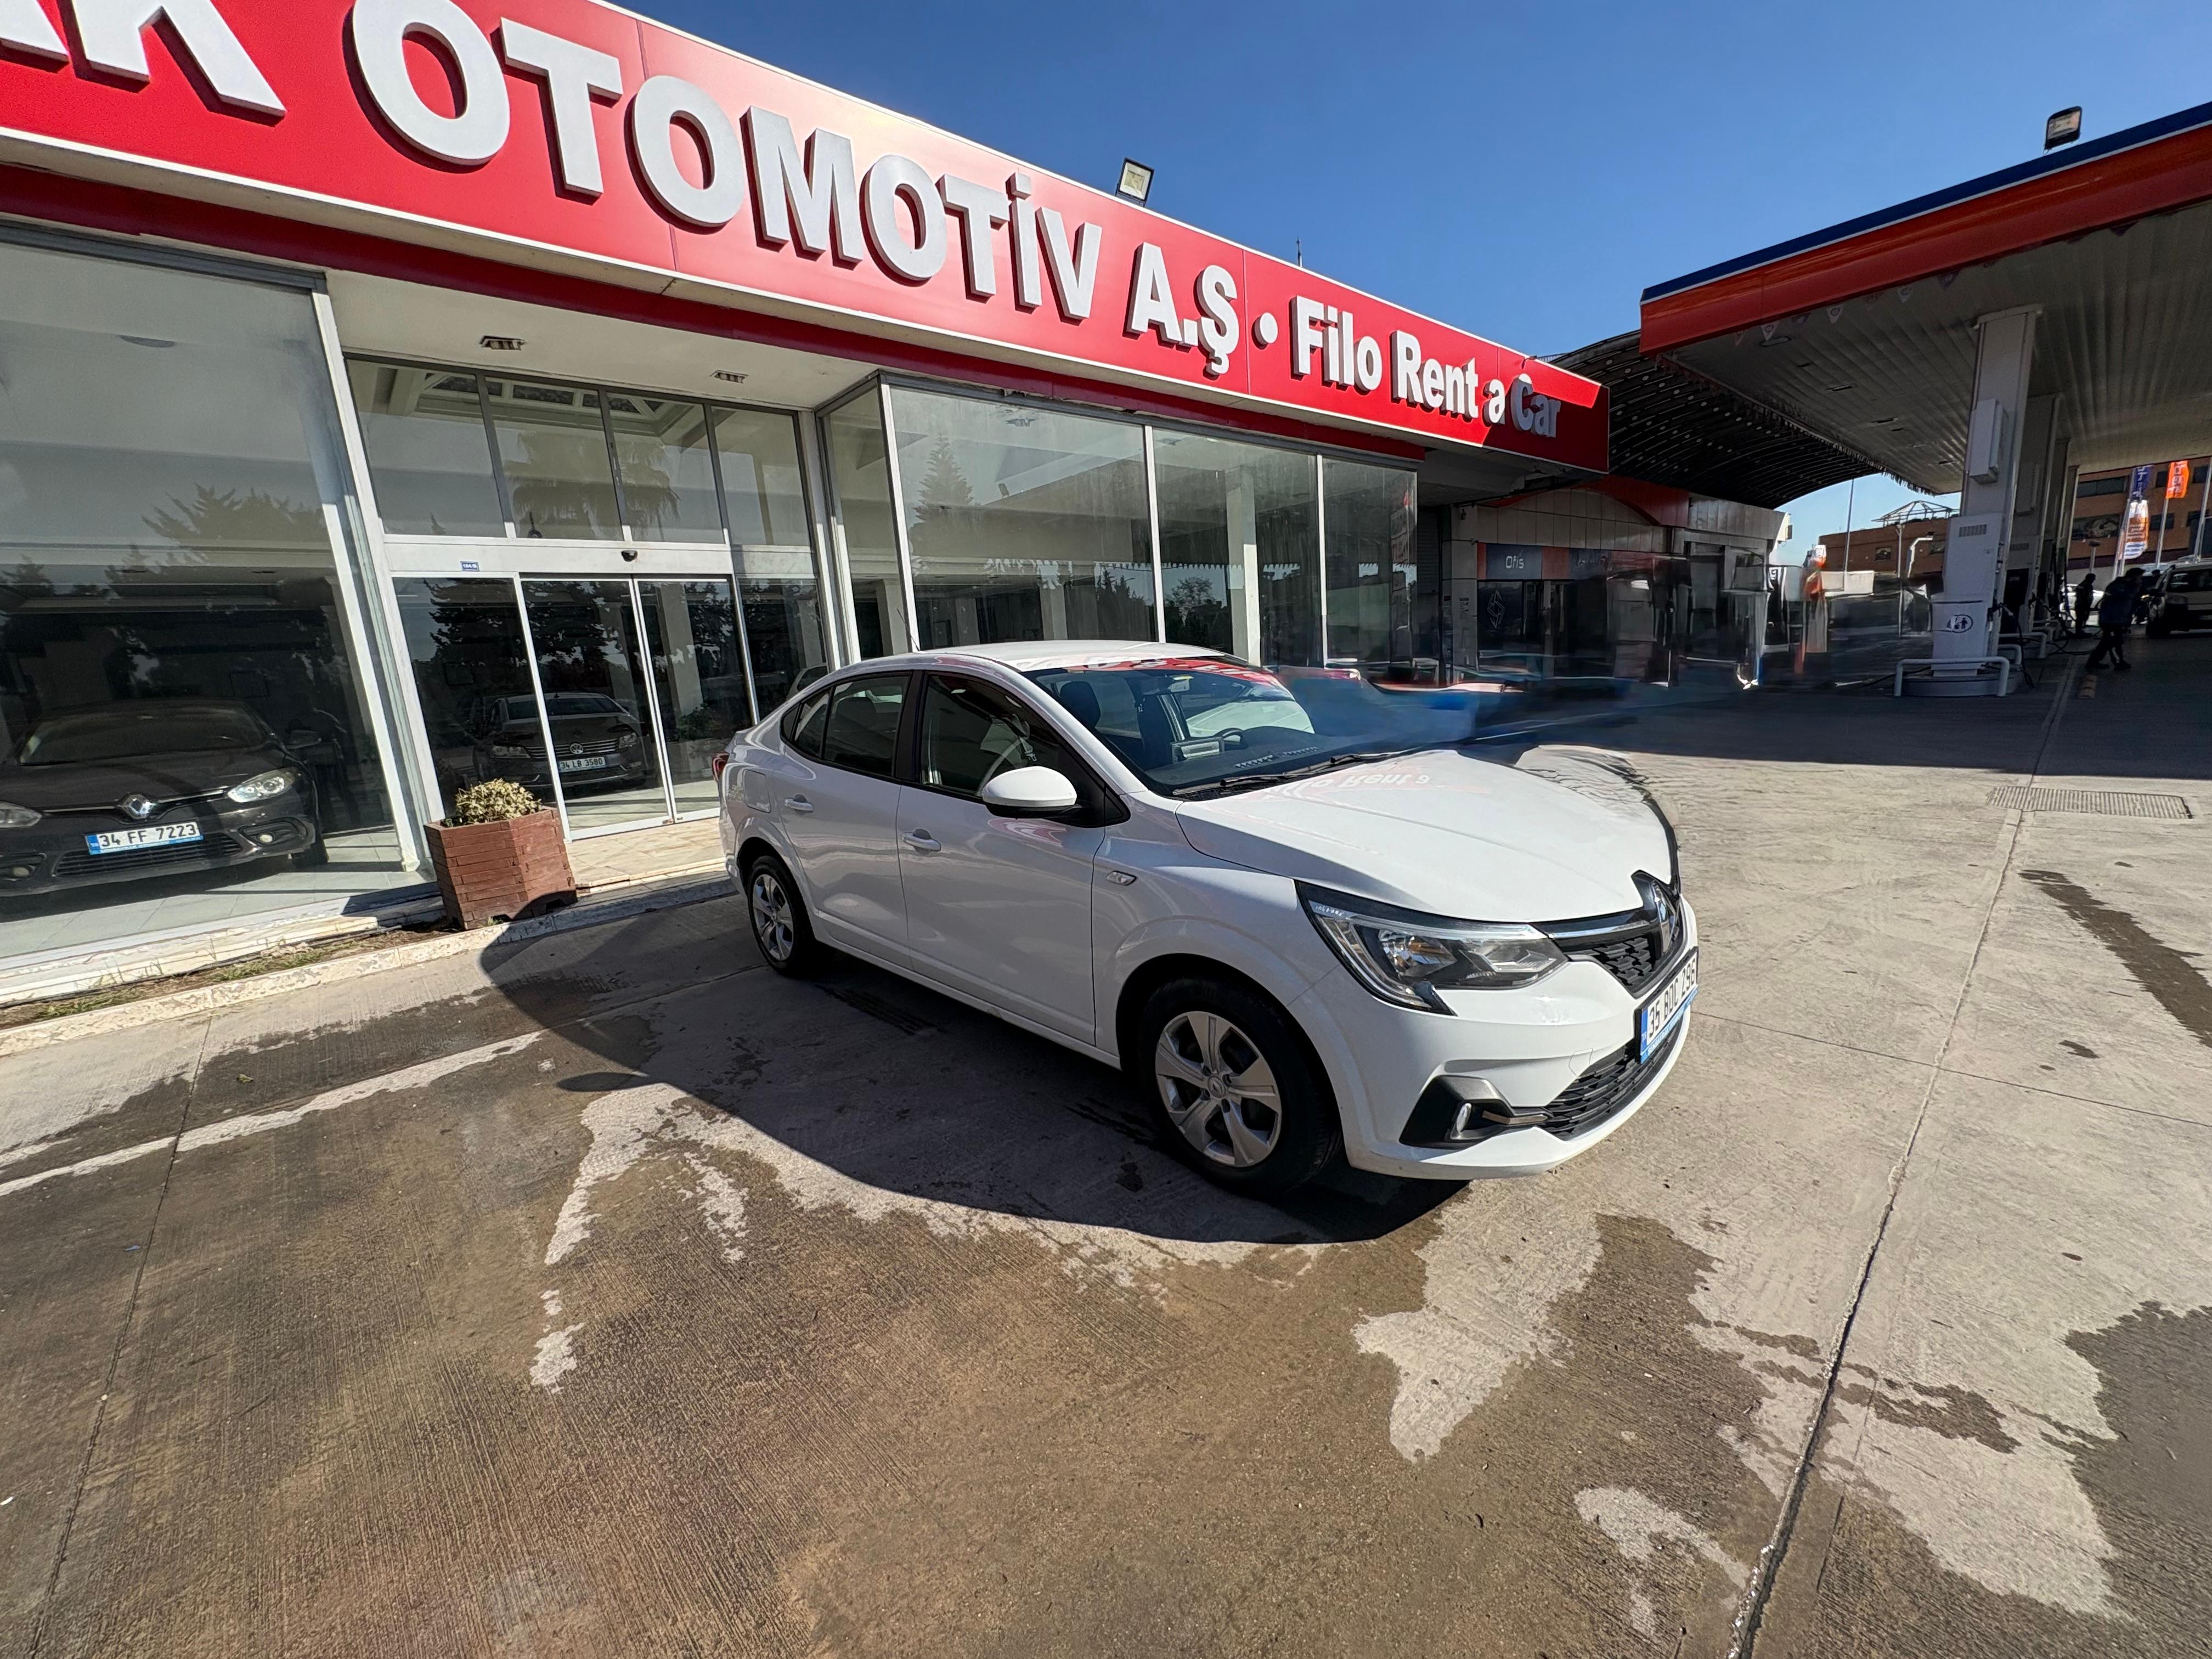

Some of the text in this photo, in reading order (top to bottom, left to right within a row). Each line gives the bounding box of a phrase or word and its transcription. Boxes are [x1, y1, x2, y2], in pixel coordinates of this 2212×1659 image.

[350, 0, 1103, 319] OTOMOTİV
[1293, 295, 1382, 391] Filo
[1392, 329, 1479, 419] Rent
[1484, 379, 1505, 424] a
[1511, 373, 1561, 438] Car
[99, 833, 121, 847] 34
[127, 830, 148, 844] FF
[155, 823, 197, 840] 7223
[1649, 1000, 1660, 1037] 35
[1681, 960, 1696, 997] 296
